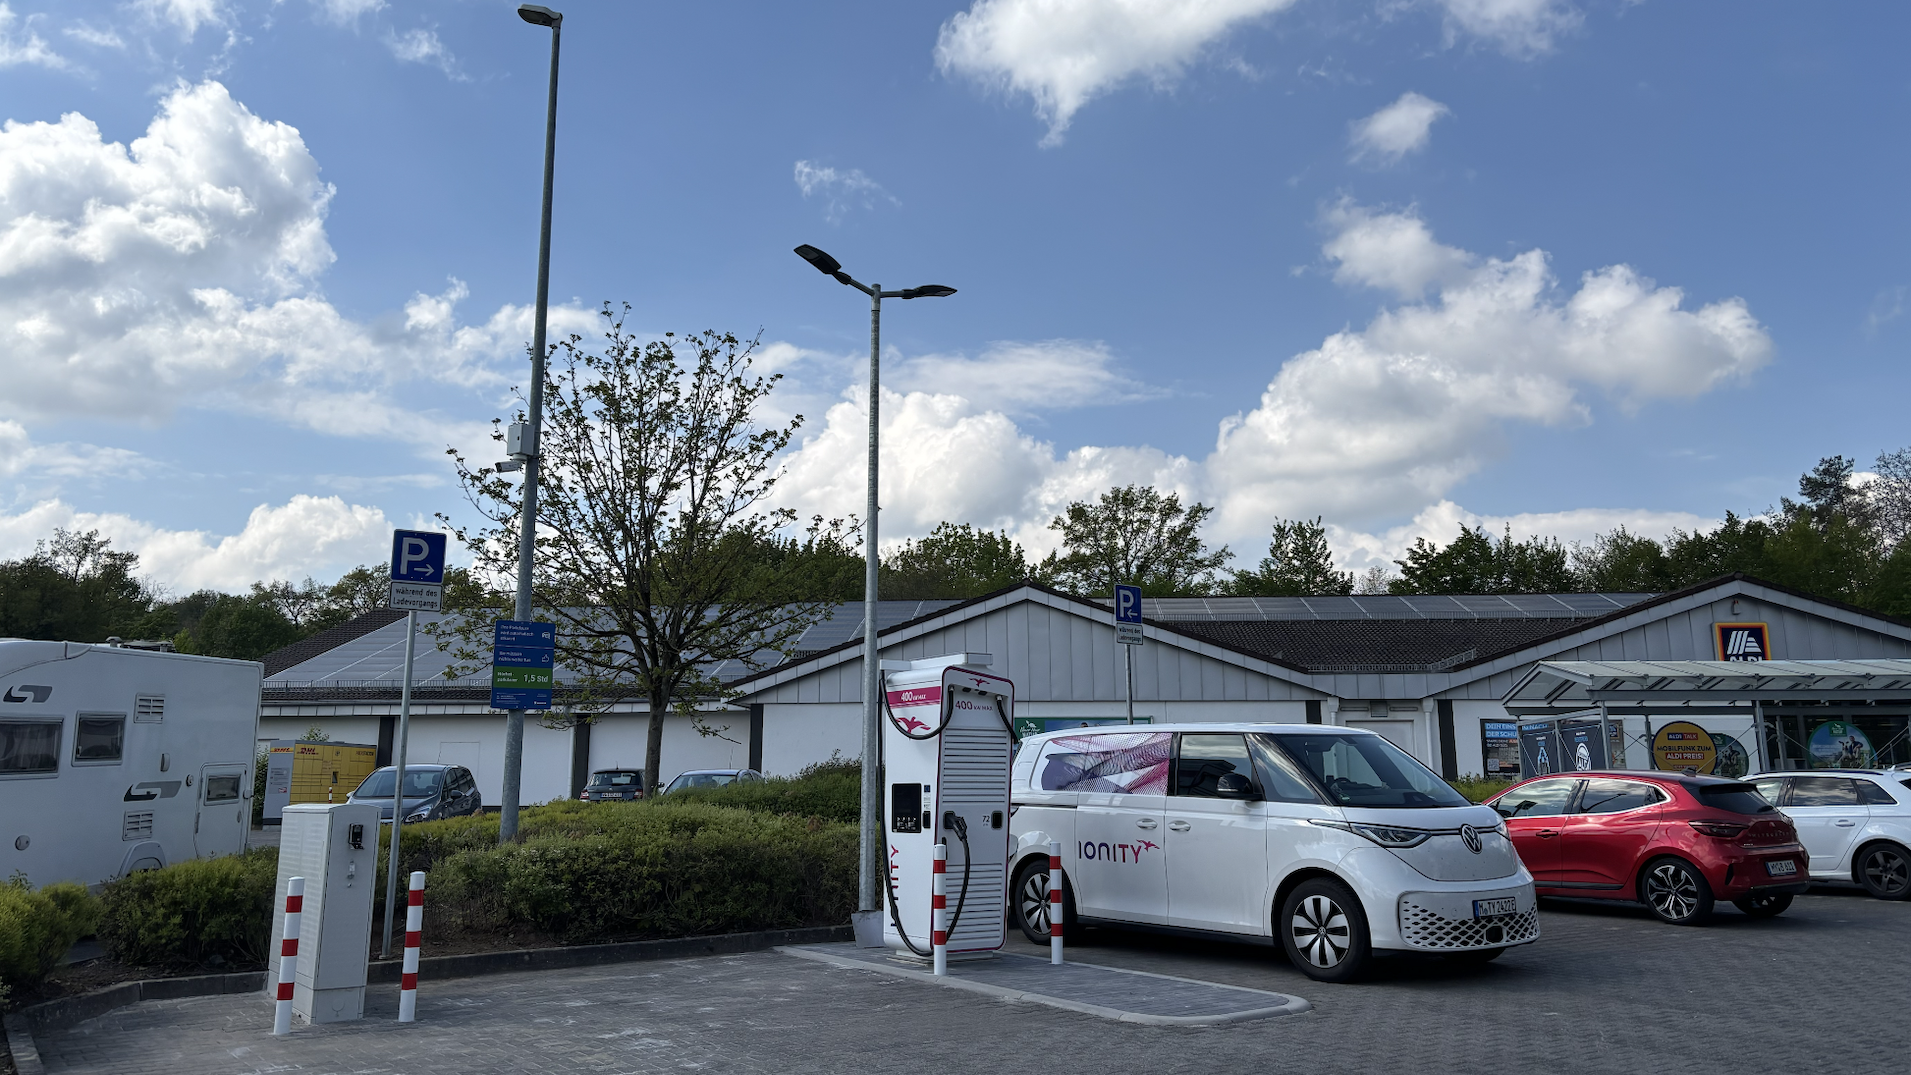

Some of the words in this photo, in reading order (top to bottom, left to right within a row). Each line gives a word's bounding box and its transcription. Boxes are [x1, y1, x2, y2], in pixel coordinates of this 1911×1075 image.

[400, 537, 429, 575] P
[396, 587, 424, 596] während
[425, 589, 438, 597] des
[393, 597, 438, 608] Ladevorgangs
[1119, 589, 1134, 618] P
[523, 674, 536, 683] 1,5
[537, 675, 549, 683] Std
[901, 691, 913, 701] 400
[955, 700, 973, 710] 400
